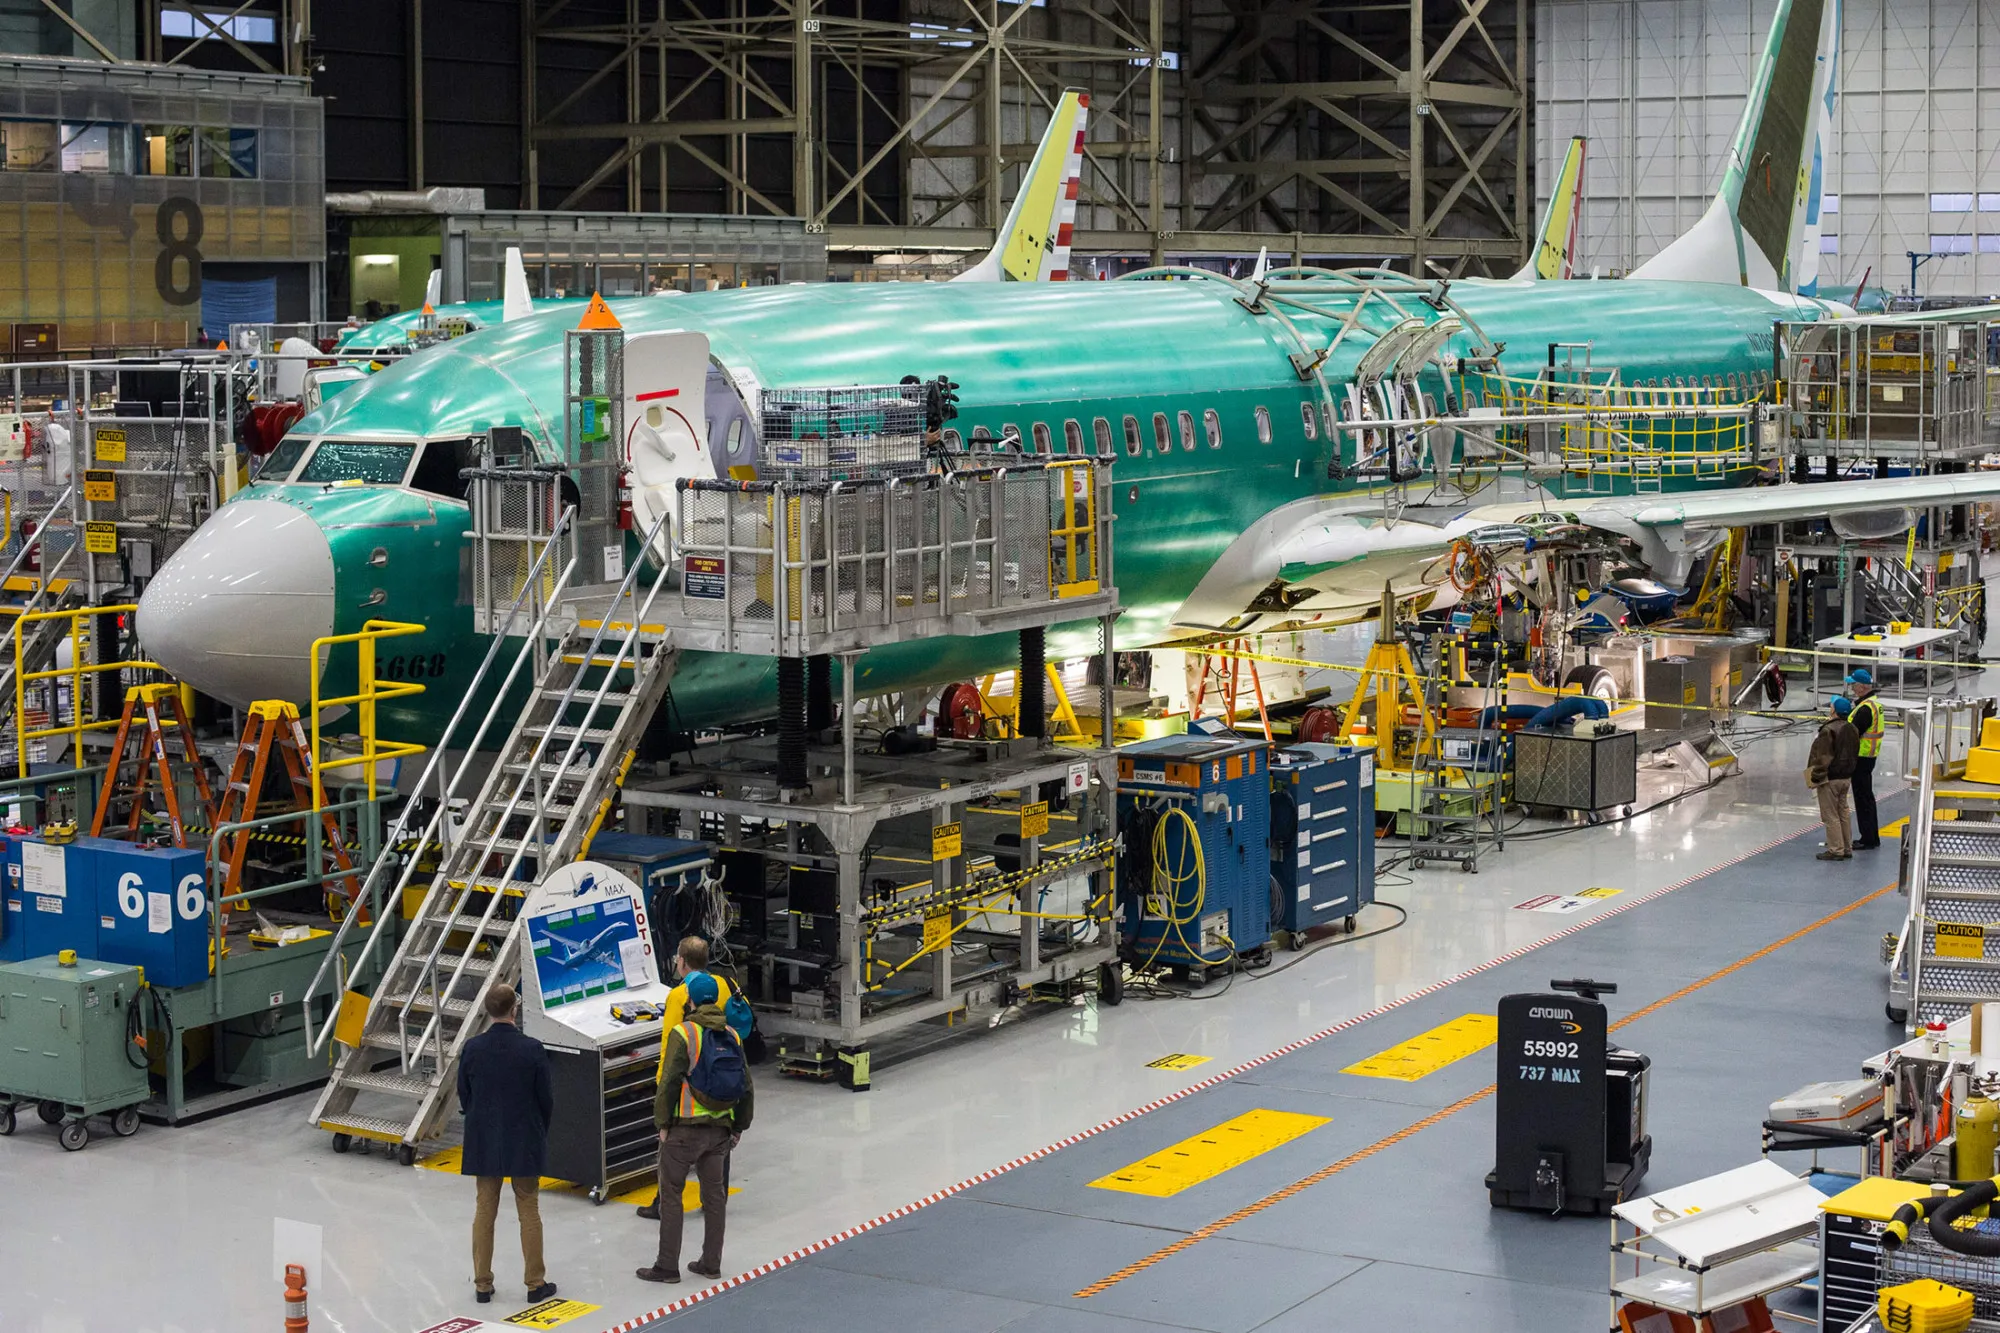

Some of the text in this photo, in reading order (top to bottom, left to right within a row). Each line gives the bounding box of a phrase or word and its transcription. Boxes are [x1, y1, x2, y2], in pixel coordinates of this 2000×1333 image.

[156, 197, 204, 306] 8
[598, 303, 605, 313] 2
[97, 431, 124, 441] CAUTION
[88, 524, 115, 532] CAUTION
[1136, 772, 1154, 781] CSMS
[1212, 764, 1220, 781] 6
[1024, 804, 1046, 816] CAUTION
[934, 824, 960, 838] CAUTION
[118, 872, 145, 918] 6
[177, 873, 205, 920] 6
[604, 883, 626, 897] MAX
[1940, 925, 1981, 936] CAUTION
[1529, 1007, 1573, 1020] CROWN
[1524, 1041, 1579, 1058] 55992
[1520, 1066, 1581, 1083] 737 MAX
